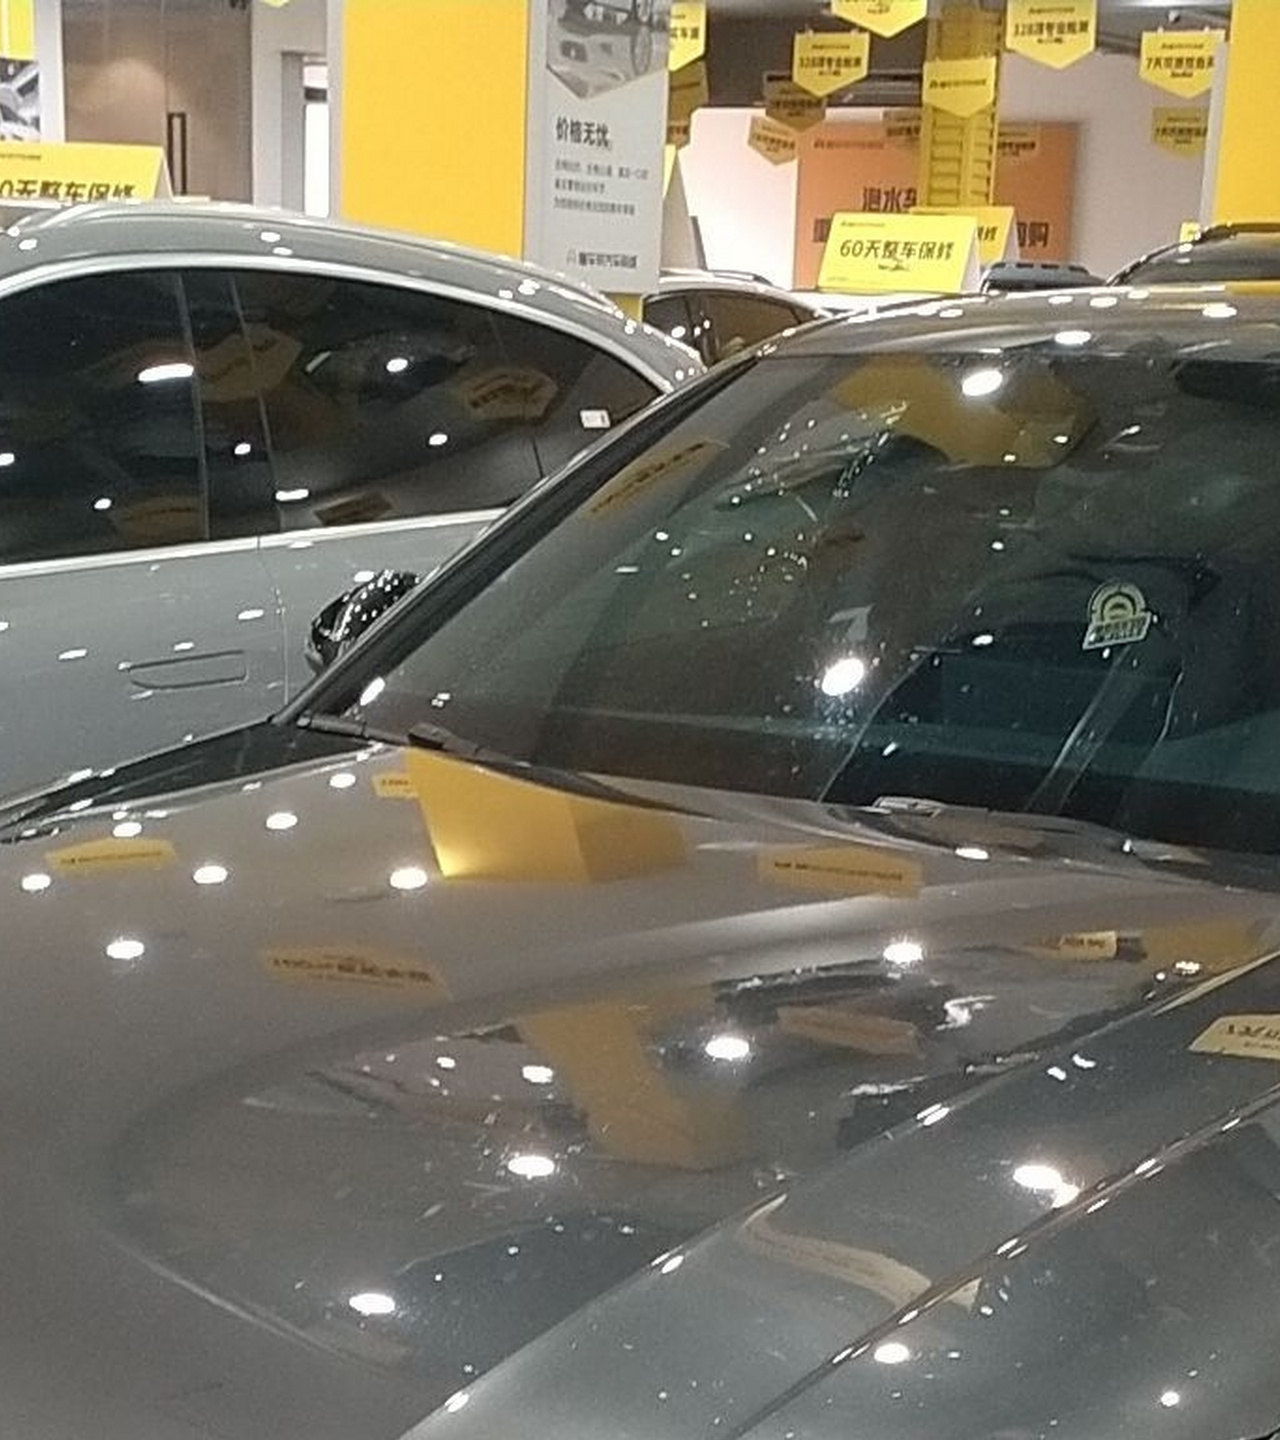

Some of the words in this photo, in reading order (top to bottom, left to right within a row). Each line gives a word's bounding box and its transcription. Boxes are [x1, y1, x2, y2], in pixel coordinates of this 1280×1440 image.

[840, 239, 955, 261] 60天整车保修
